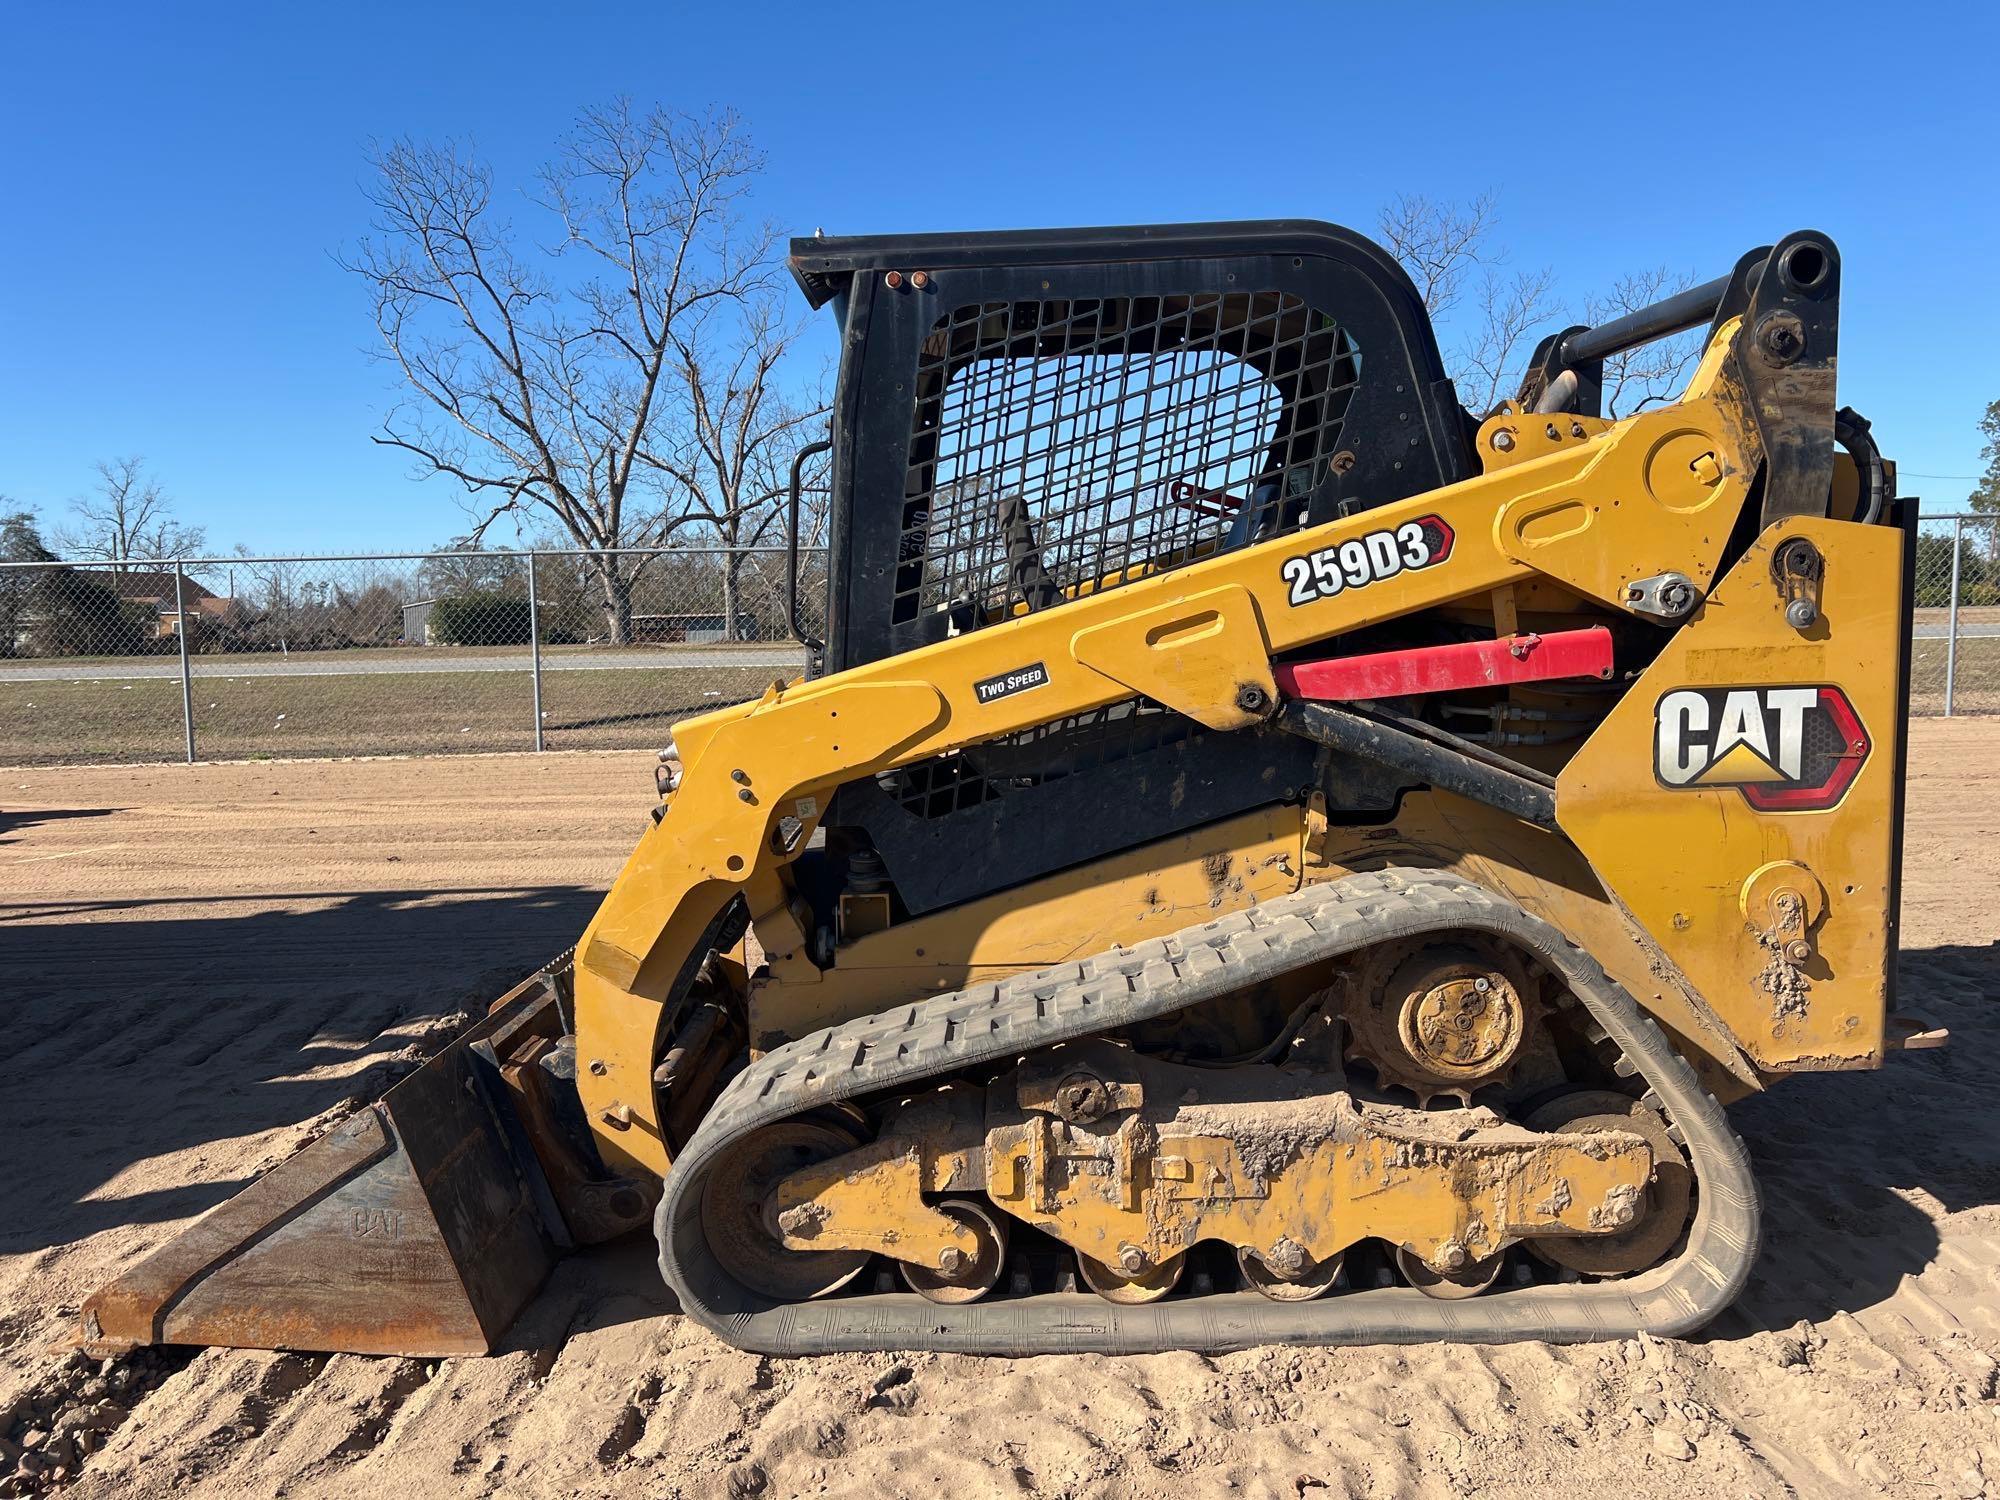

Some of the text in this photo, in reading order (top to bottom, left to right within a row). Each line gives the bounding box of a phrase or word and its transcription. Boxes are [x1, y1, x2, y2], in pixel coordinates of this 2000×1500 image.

[1283, 523, 1429, 605] 259D3
[979, 669, 1042, 698] TWO SPEED
[1660, 689, 1817, 785] CAT
[350, 1207, 403, 1239] CAT
